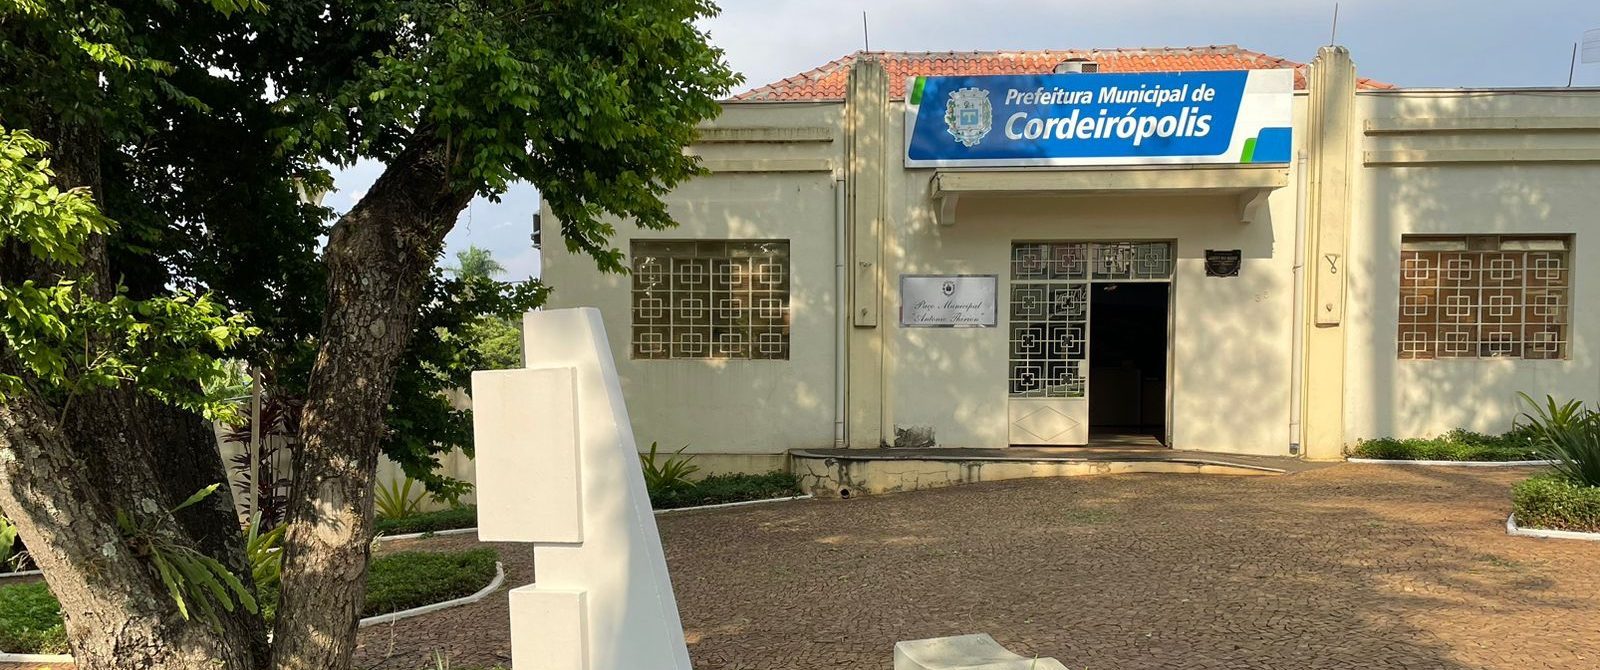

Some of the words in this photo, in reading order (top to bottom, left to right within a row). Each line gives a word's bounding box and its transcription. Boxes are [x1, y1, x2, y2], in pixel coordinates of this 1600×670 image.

[1005, 86, 1093, 105] Prefeitura
[1098, 83, 1188, 107] Municipal
[1191, 83, 1215, 102] de
[1004, 106, 1212, 146] Cordeirópolis
[937, 299, 983, 313] Municipal
